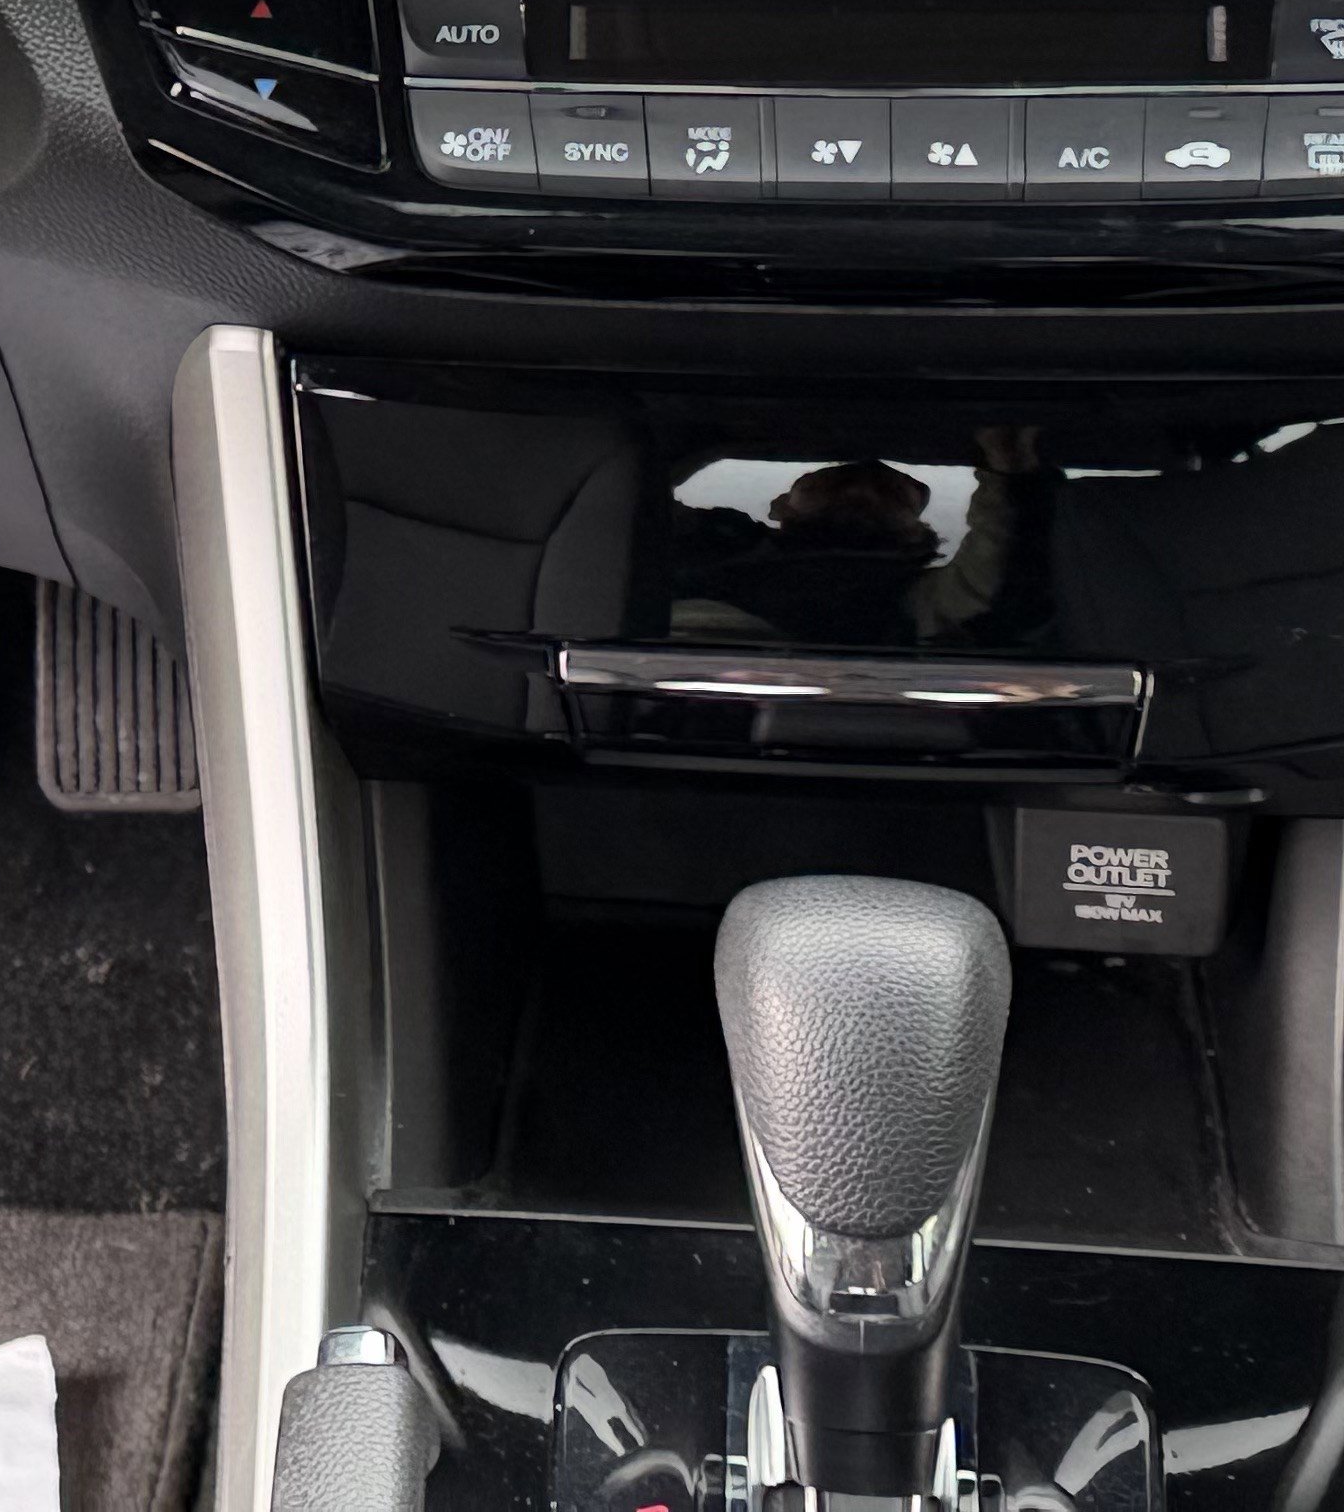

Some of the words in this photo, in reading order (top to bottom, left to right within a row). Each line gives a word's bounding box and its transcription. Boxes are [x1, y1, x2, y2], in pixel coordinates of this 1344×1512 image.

[435, 24, 500, 44] AUTO
[466, 126, 510, 146] ON/
[465, 142, 511, 163] OFF
[564, 143, 629, 162] SYNC
[1057, 146, 1110, 170] A/C
[1070, 844, 1169, 869] POWER
[1067, 862, 1172, 887] OUTLET
